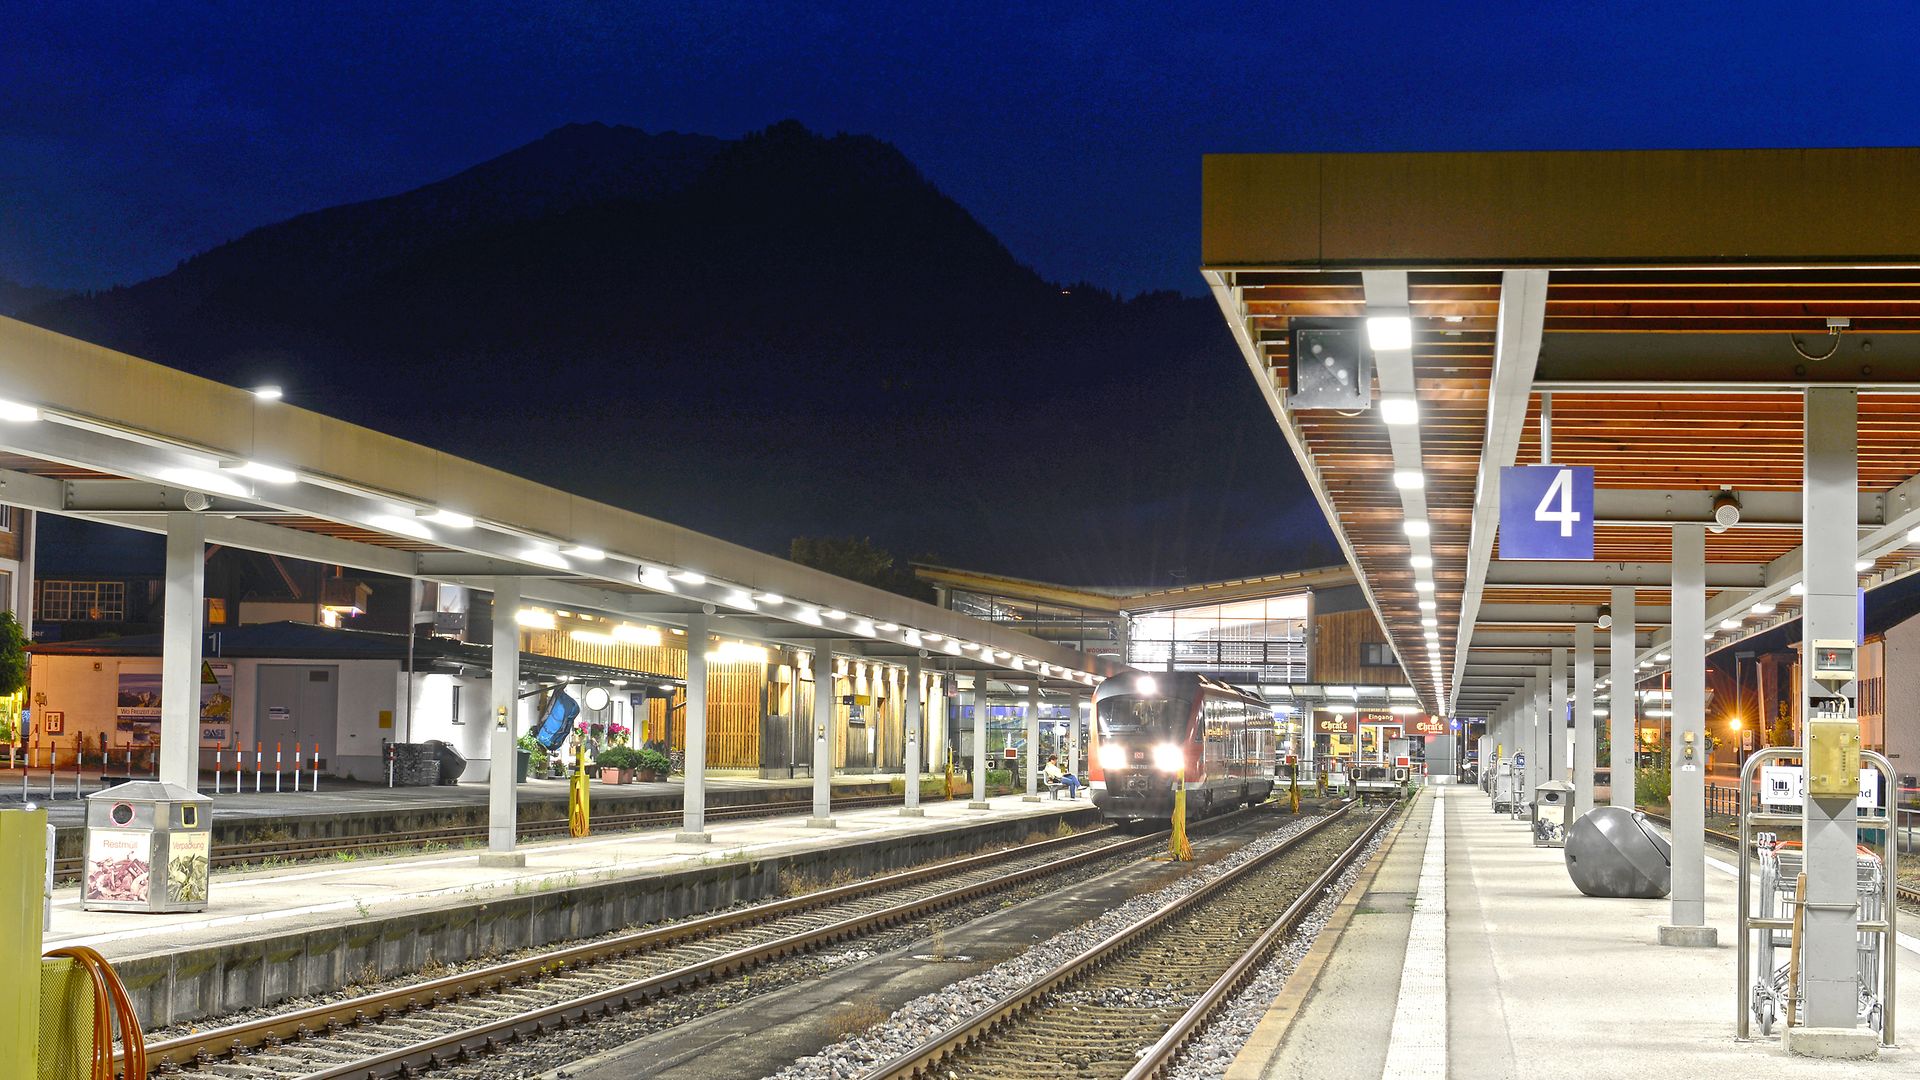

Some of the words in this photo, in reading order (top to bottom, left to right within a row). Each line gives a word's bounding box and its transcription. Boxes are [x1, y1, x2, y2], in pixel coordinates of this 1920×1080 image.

[1535, 469, 1580, 537] 4
[208, 633, 217, 652] 1
[1368, 713, 1394, 722] Eingang
[1451, 718, 1458, 728] 4
[103, 840, 138, 849] Restmüll
[173, 841, 204, 851] Verpackung
